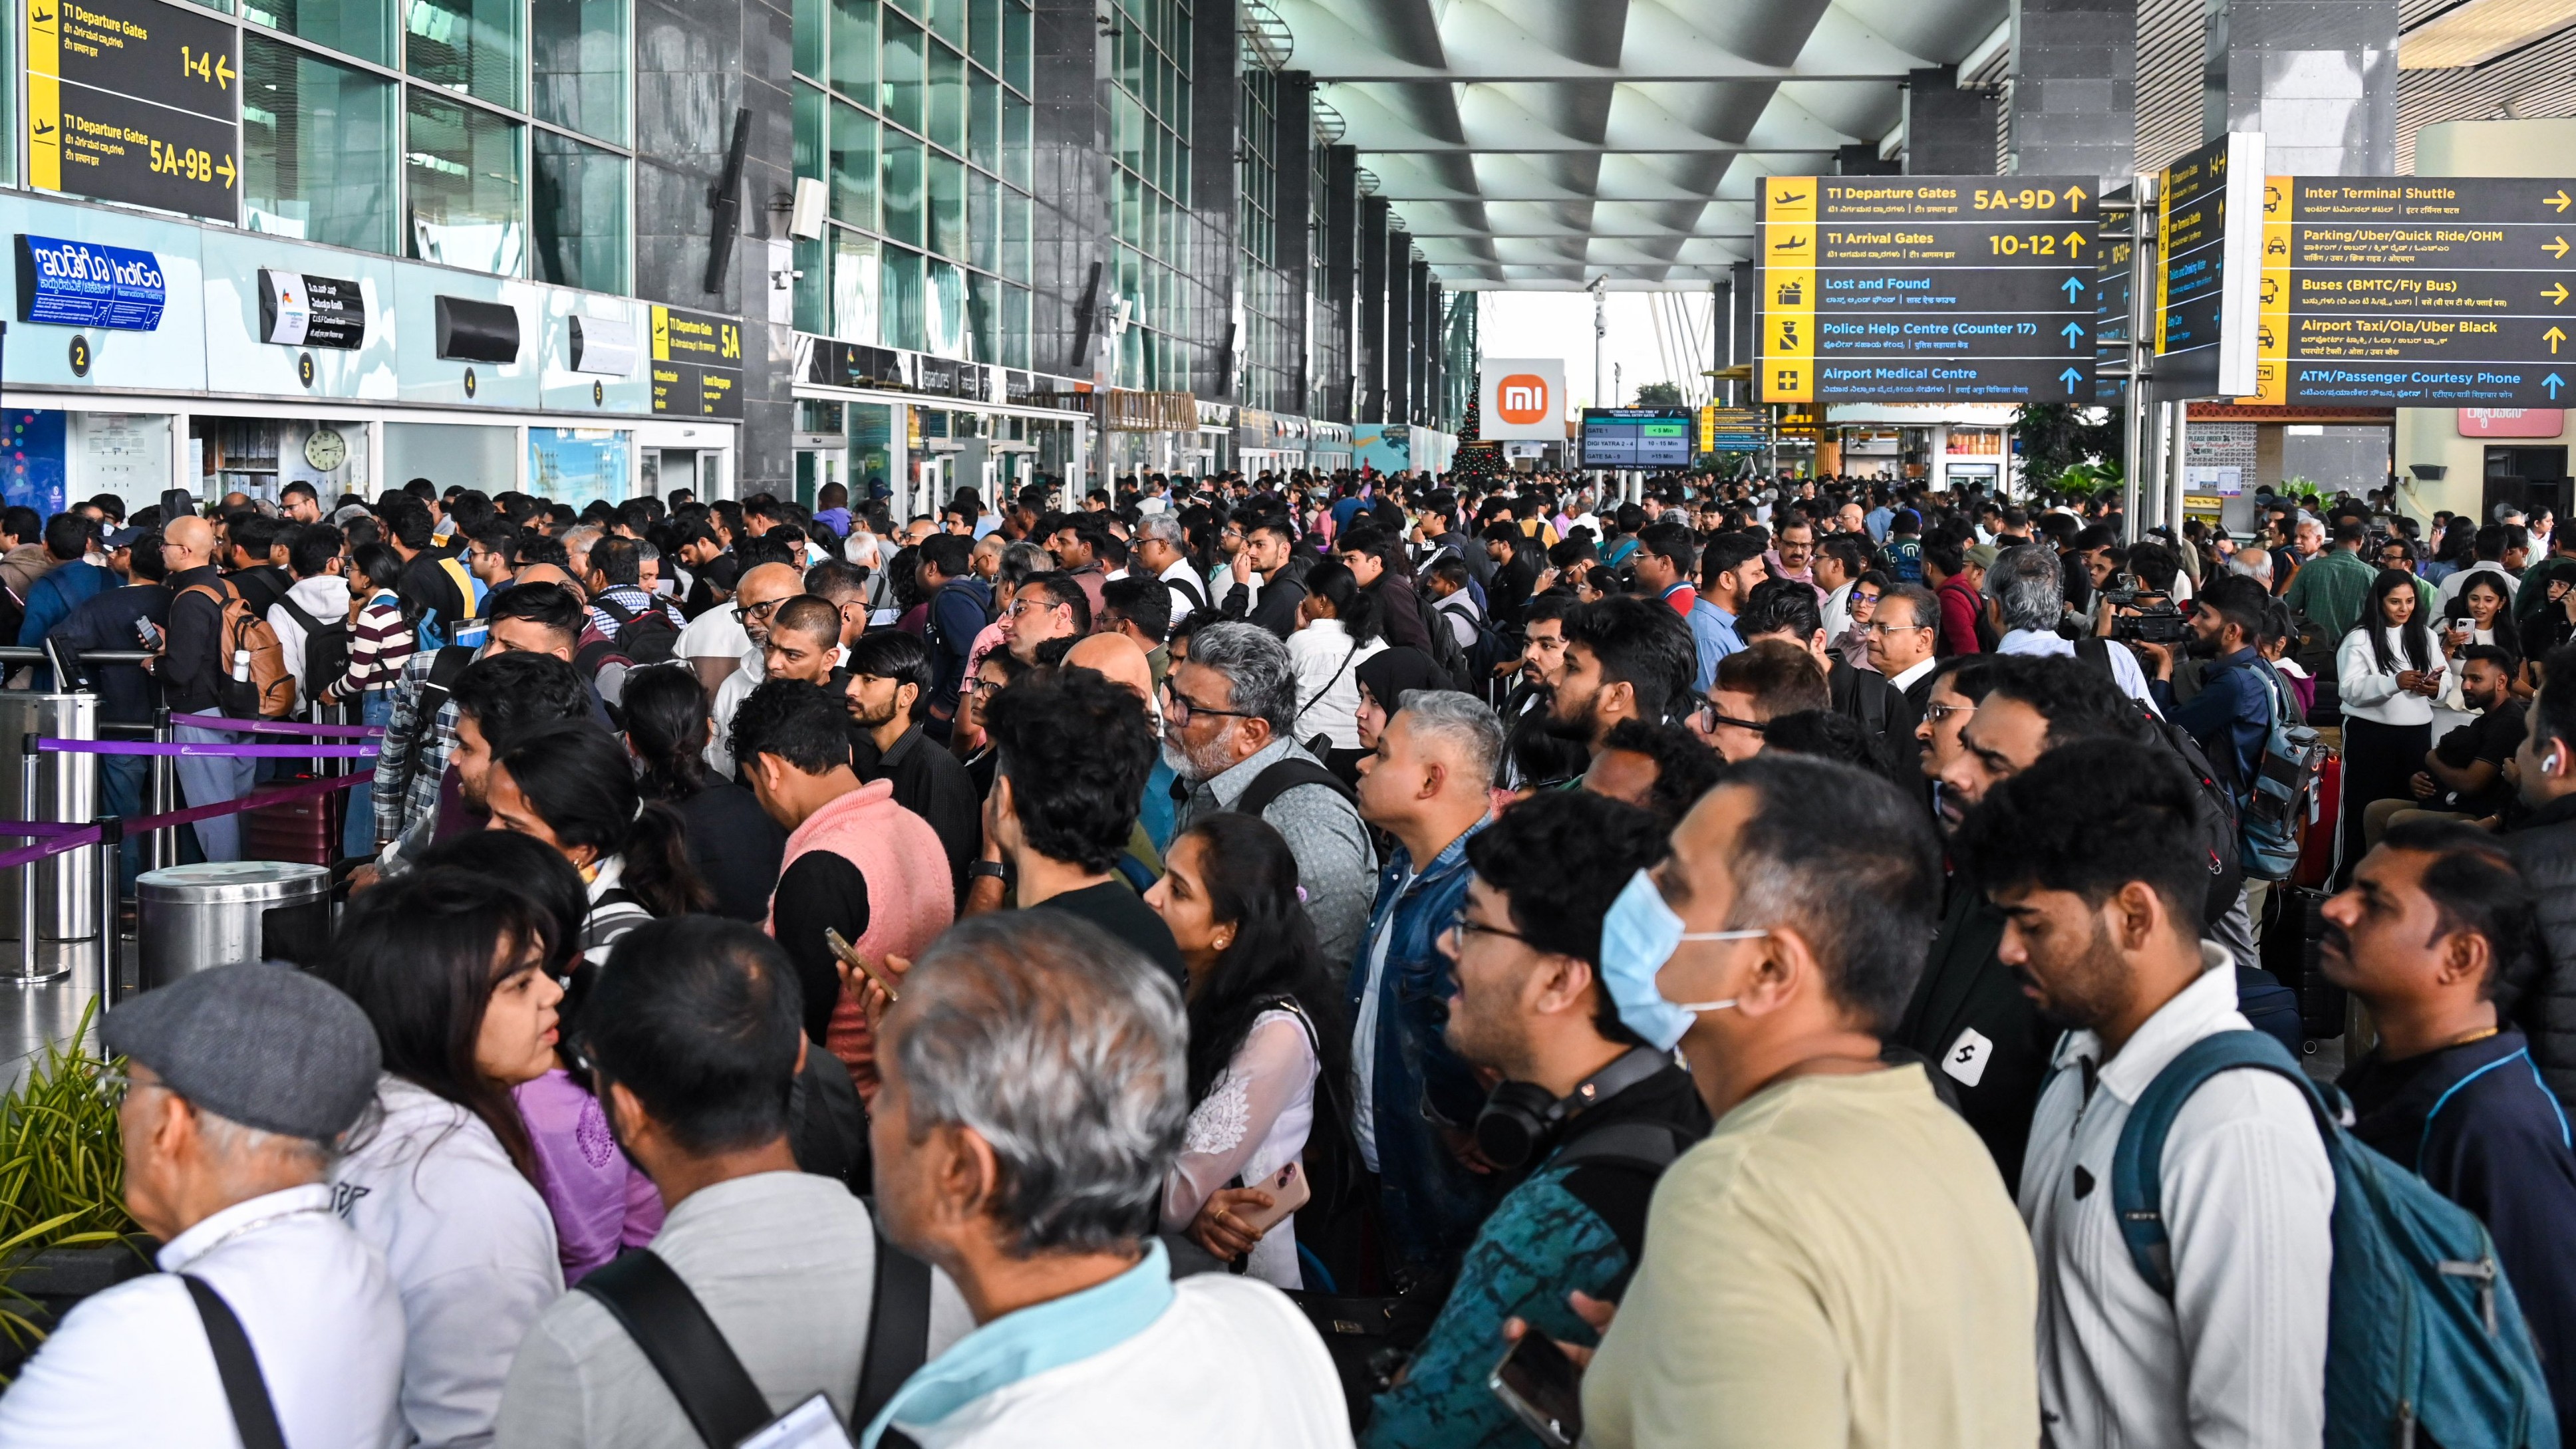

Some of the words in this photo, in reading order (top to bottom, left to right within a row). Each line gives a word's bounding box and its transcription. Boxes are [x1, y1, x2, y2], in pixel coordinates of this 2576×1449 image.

[63, 3, 73, 18] T1
[76, 6, 120, 32] Departure
[122, 21, 147, 40] Gates
[182, 46, 210, 82] 1-4
[64, 113, 74, 129] T1
[77, 116, 122, 140] Departure
[124, 128, 148, 146] Gates
[150, 140, 212, 182] 5A-9B
[1828, 188, 1841, 198] T1
[1846, 188, 1914, 200] Departure
[1918, 188, 1956, 198] Gates
[1973, 190, 2056, 209] 5A-9D
[2305, 188, 2338, 198] Inter
[2342, 188, 2400, 198] Terminal
[2406, 188, 2455, 199] Shuttle
[1828, 233, 1841, 243] T1
[1846, 233, 1891, 243] Arrival
[1895, 233, 1933, 243] Gates
[2304, 229, 2432, 242] Parking/Uber/Quick
[2436, 230, 2502, 242] Ride/OHM
[1989, 235, 2055, 255] 10-12
[111, 259, 162, 288] IndiGo
[1826, 279, 1854, 289] Lost
[1858, 278, 1884, 289] and
[1888, 278, 1930, 289] Found
[2303, 279, 2343, 290] Buses
[2347, 279, 2422, 293] (BMTC/Fly
[2426, 281, 2457, 292] Bus)
[118, 288, 163, 302] Reservations/Ticketing
[676, 318, 700, 334] Departure
[700, 323, 712, 336] Gate
[1824, 323, 1864, 334] Police
[1868, 323, 1900, 336] Help
[1904, 323, 1949, 334] Centre
[1953, 323, 2013, 335] (Counter
[2017, 323, 2037, 334] 17)
[2301, 320, 2351, 332] Airport
[2356, 320, 2455, 333] Taxi/Ola/Uber
[2460, 321, 2497, 332] Black
[722, 324, 740, 359] 5A
[75, 344, 84, 366] 2
[303, 360, 310, 380] 3
[1823, 368, 1872, 380] Airport
[1876, 368, 1927, 378] Medical
[1932, 368, 1977, 378] Centre
[2300, 370, 2407, 384] ATM/Passenger
[2412, 372, 2473, 384] Courtesy
[2478, 372, 2520, 383] Phone
[467, 376, 474, 391] 4
[595, 386, 601, 400] 5
